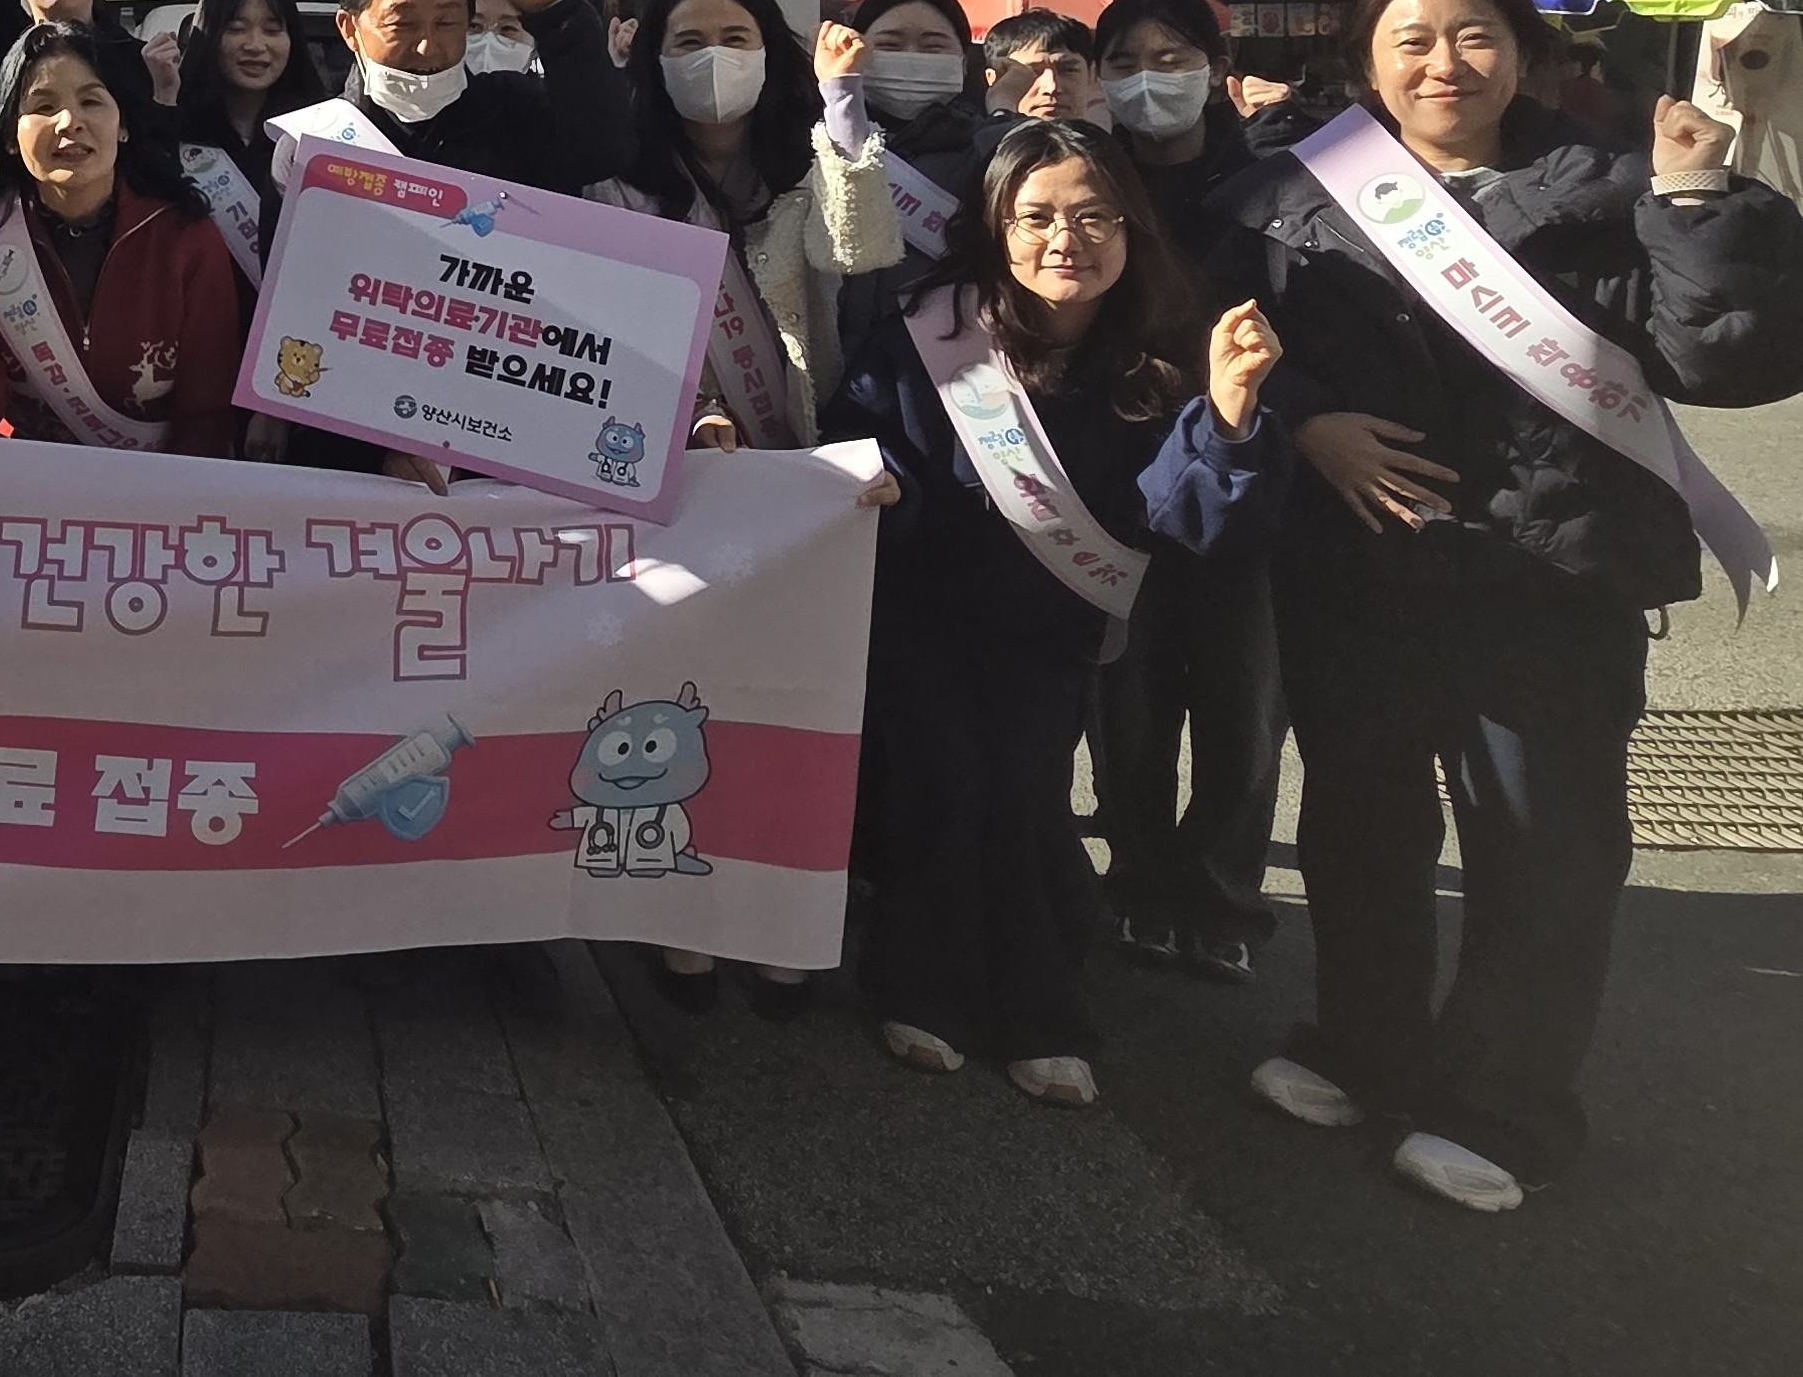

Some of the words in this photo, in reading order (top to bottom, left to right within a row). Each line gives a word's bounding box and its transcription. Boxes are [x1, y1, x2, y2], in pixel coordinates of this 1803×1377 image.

[327, 162, 389, 196] 예방접종
[393, 179, 445, 208] 캠페인
[348, 272, 613, 366] 위탁의료기관에서
[439, 253, 536, 305] 가까운
[329, 309, 455, 369] 무료접종
[465, 344, 612, 409] 받으세요!
[1441, 258, 1532, 339] 마스크
[1526, 337, 1648, 424] 착용하기
[421, 404, 513, 442] 양산시보건소
[732, 344, 779, 439] 동시접종
[1048, 528, 1080, 547] 후
[305, 512, 637, 681] 겨울나기
[89, 755, 260, 846] 접종
